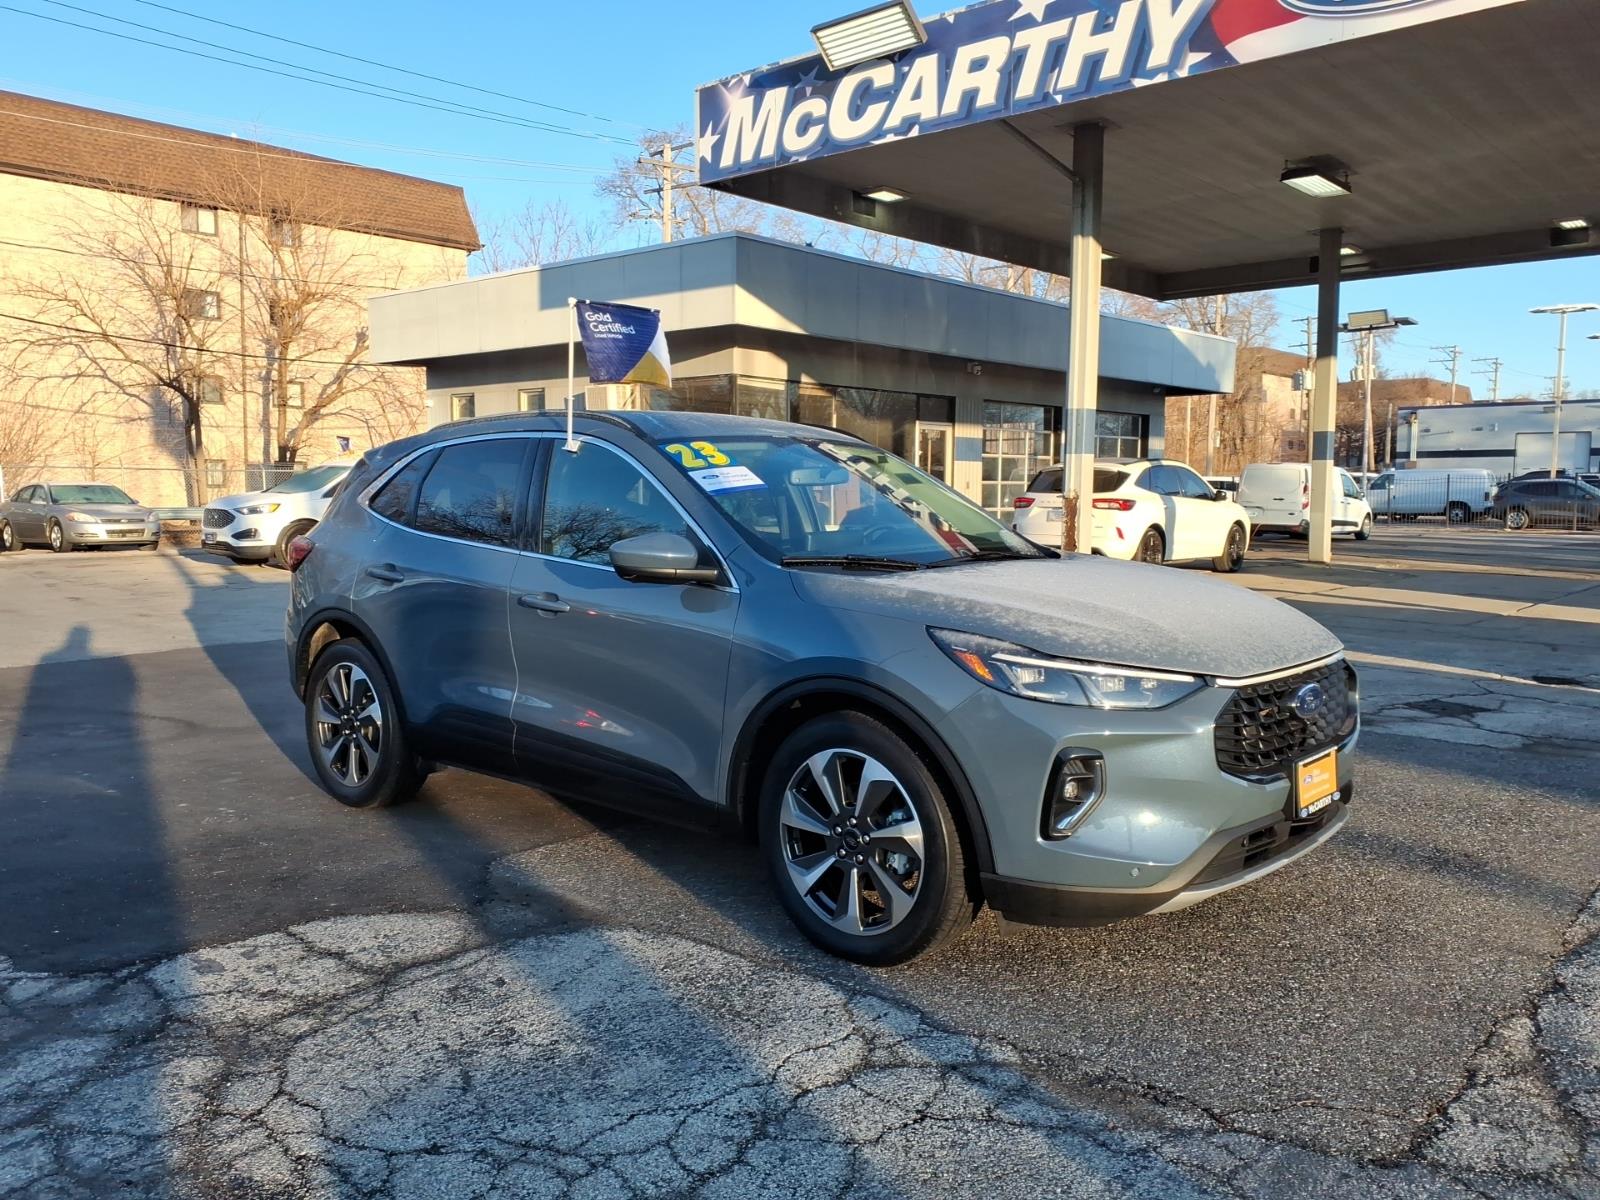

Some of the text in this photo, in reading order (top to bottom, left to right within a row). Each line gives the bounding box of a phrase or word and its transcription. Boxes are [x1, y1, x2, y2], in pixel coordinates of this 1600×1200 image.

[718, 0, 1208, 169] McCARTHY
[584, 311, 613, 323] Gold
[589, 322, 636, 335] Certified
[665, 440, 731, 468] 23
